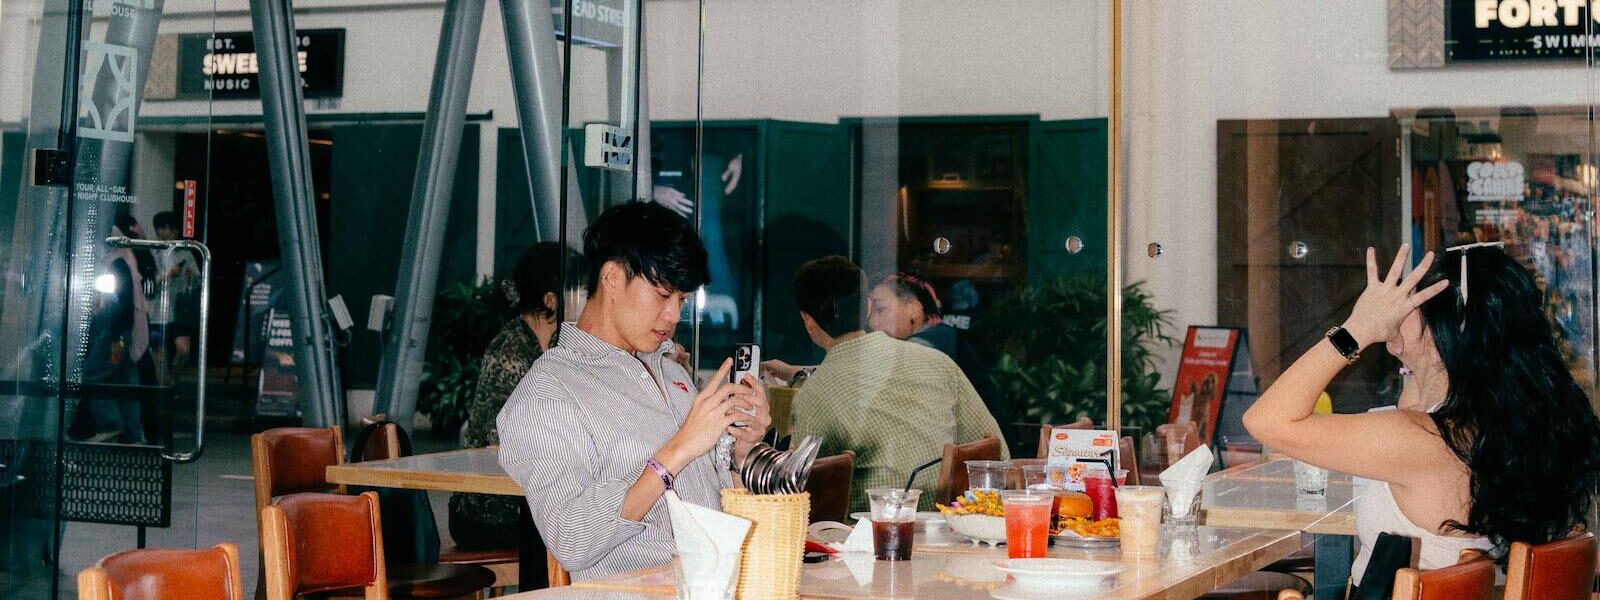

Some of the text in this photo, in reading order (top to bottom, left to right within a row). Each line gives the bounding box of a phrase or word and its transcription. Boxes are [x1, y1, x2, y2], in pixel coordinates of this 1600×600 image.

[574, 0, 624, 27] EAD STRE
[206, 38, 236, 49] EST.
[204, 78, 250, 90] MUSIC
[99, 194, 138, 203] CLUBHOUSE
[186, 188, 194, 229] PULL
